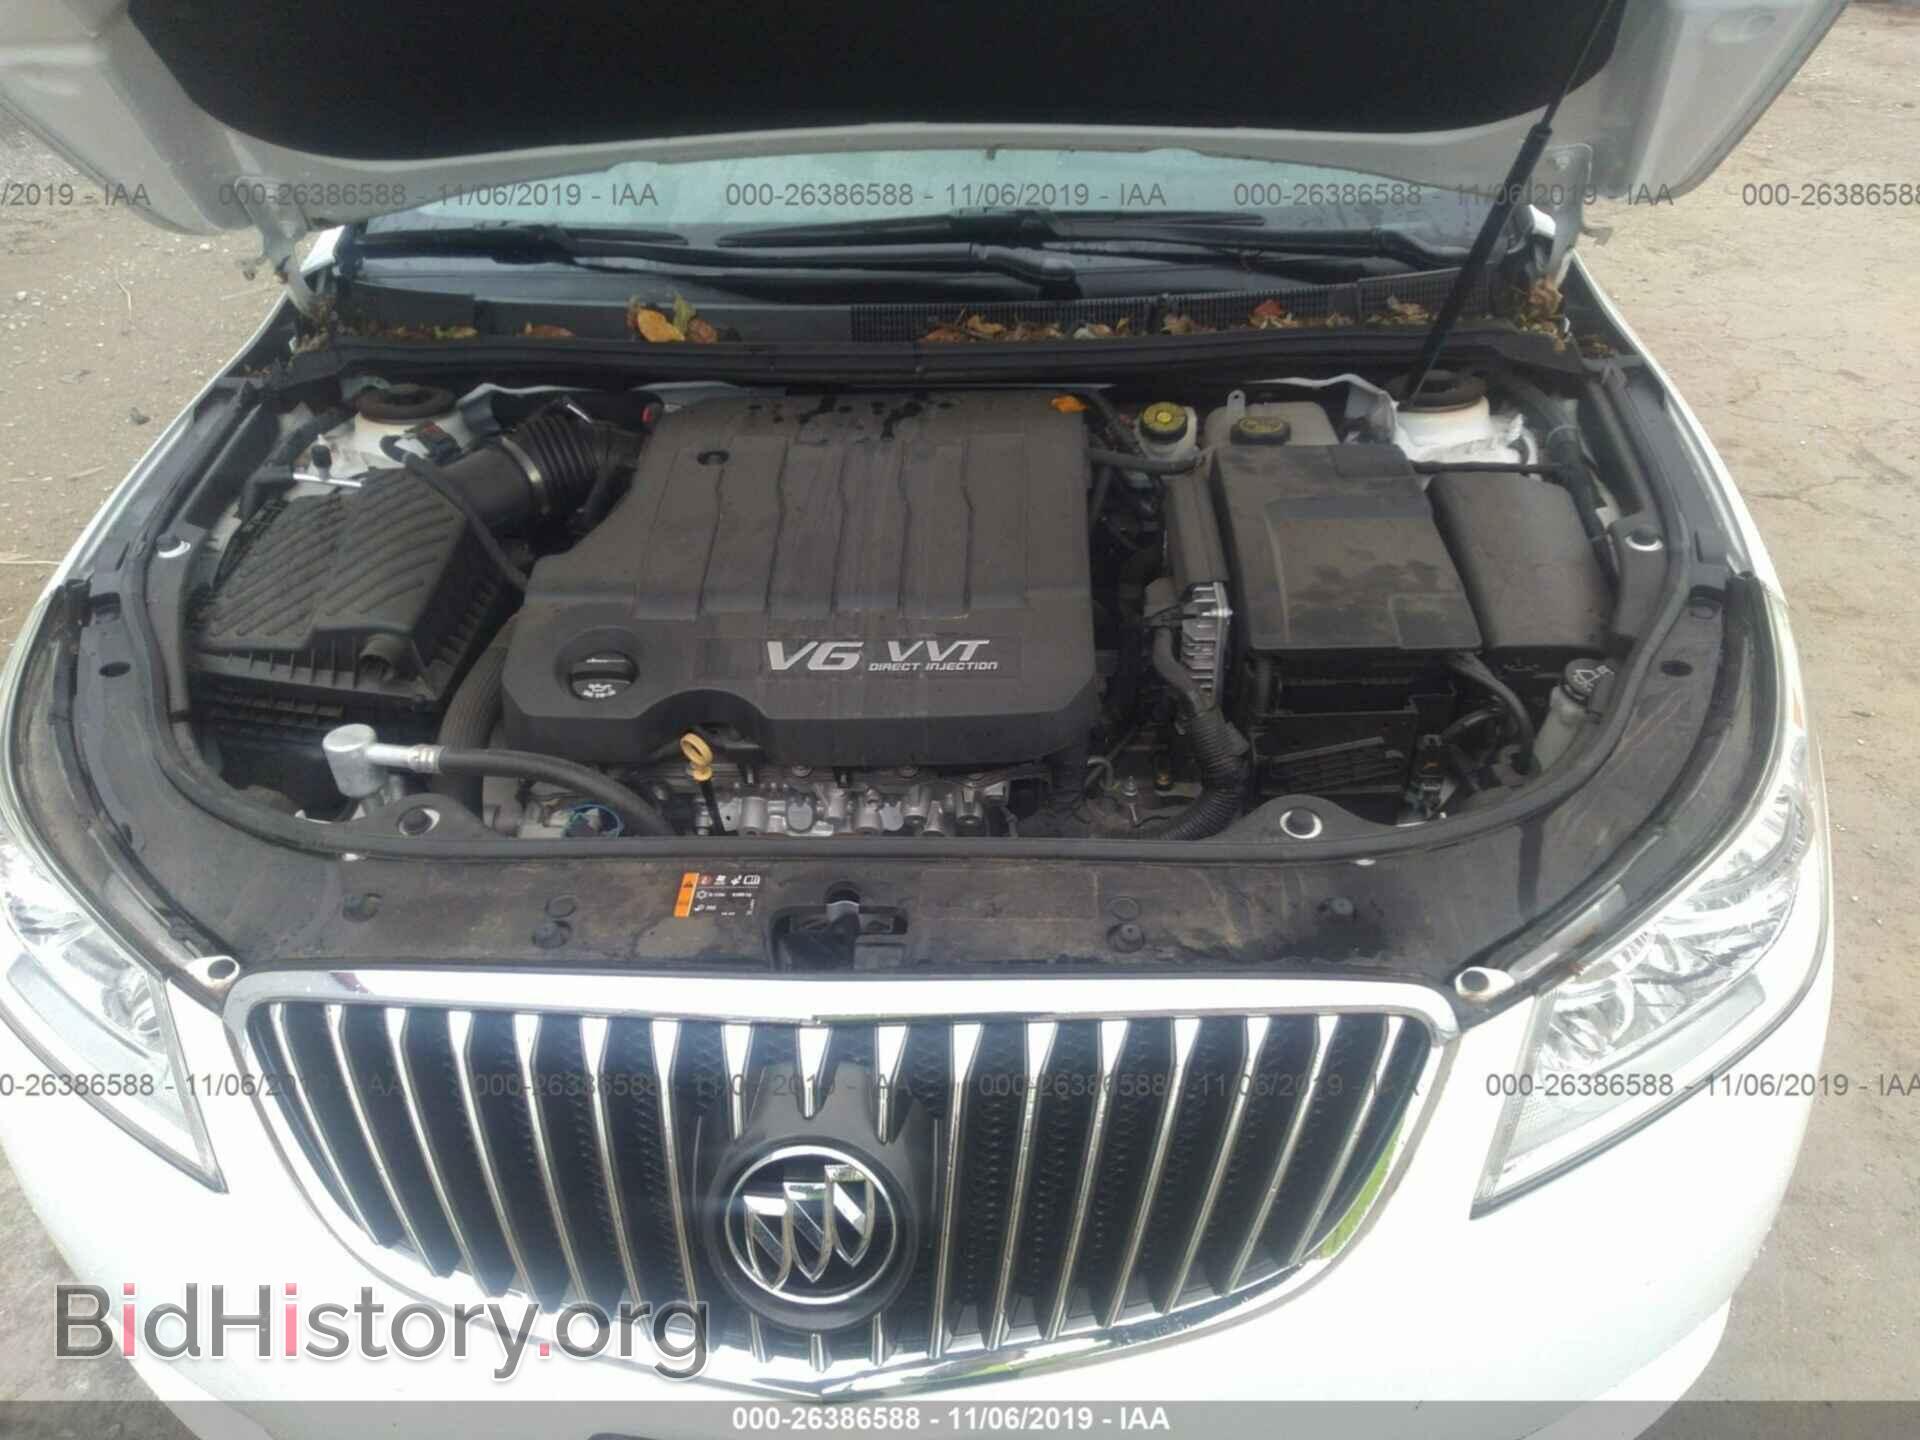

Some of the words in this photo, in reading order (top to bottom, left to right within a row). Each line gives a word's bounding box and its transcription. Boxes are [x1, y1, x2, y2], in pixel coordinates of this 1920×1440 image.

[767, 641, 864, 671] V6
[887, 640, 990, 662] VVT
[868, 661, 920, 672] DIRECT
[925, 661, 998, 672] INJECTION
